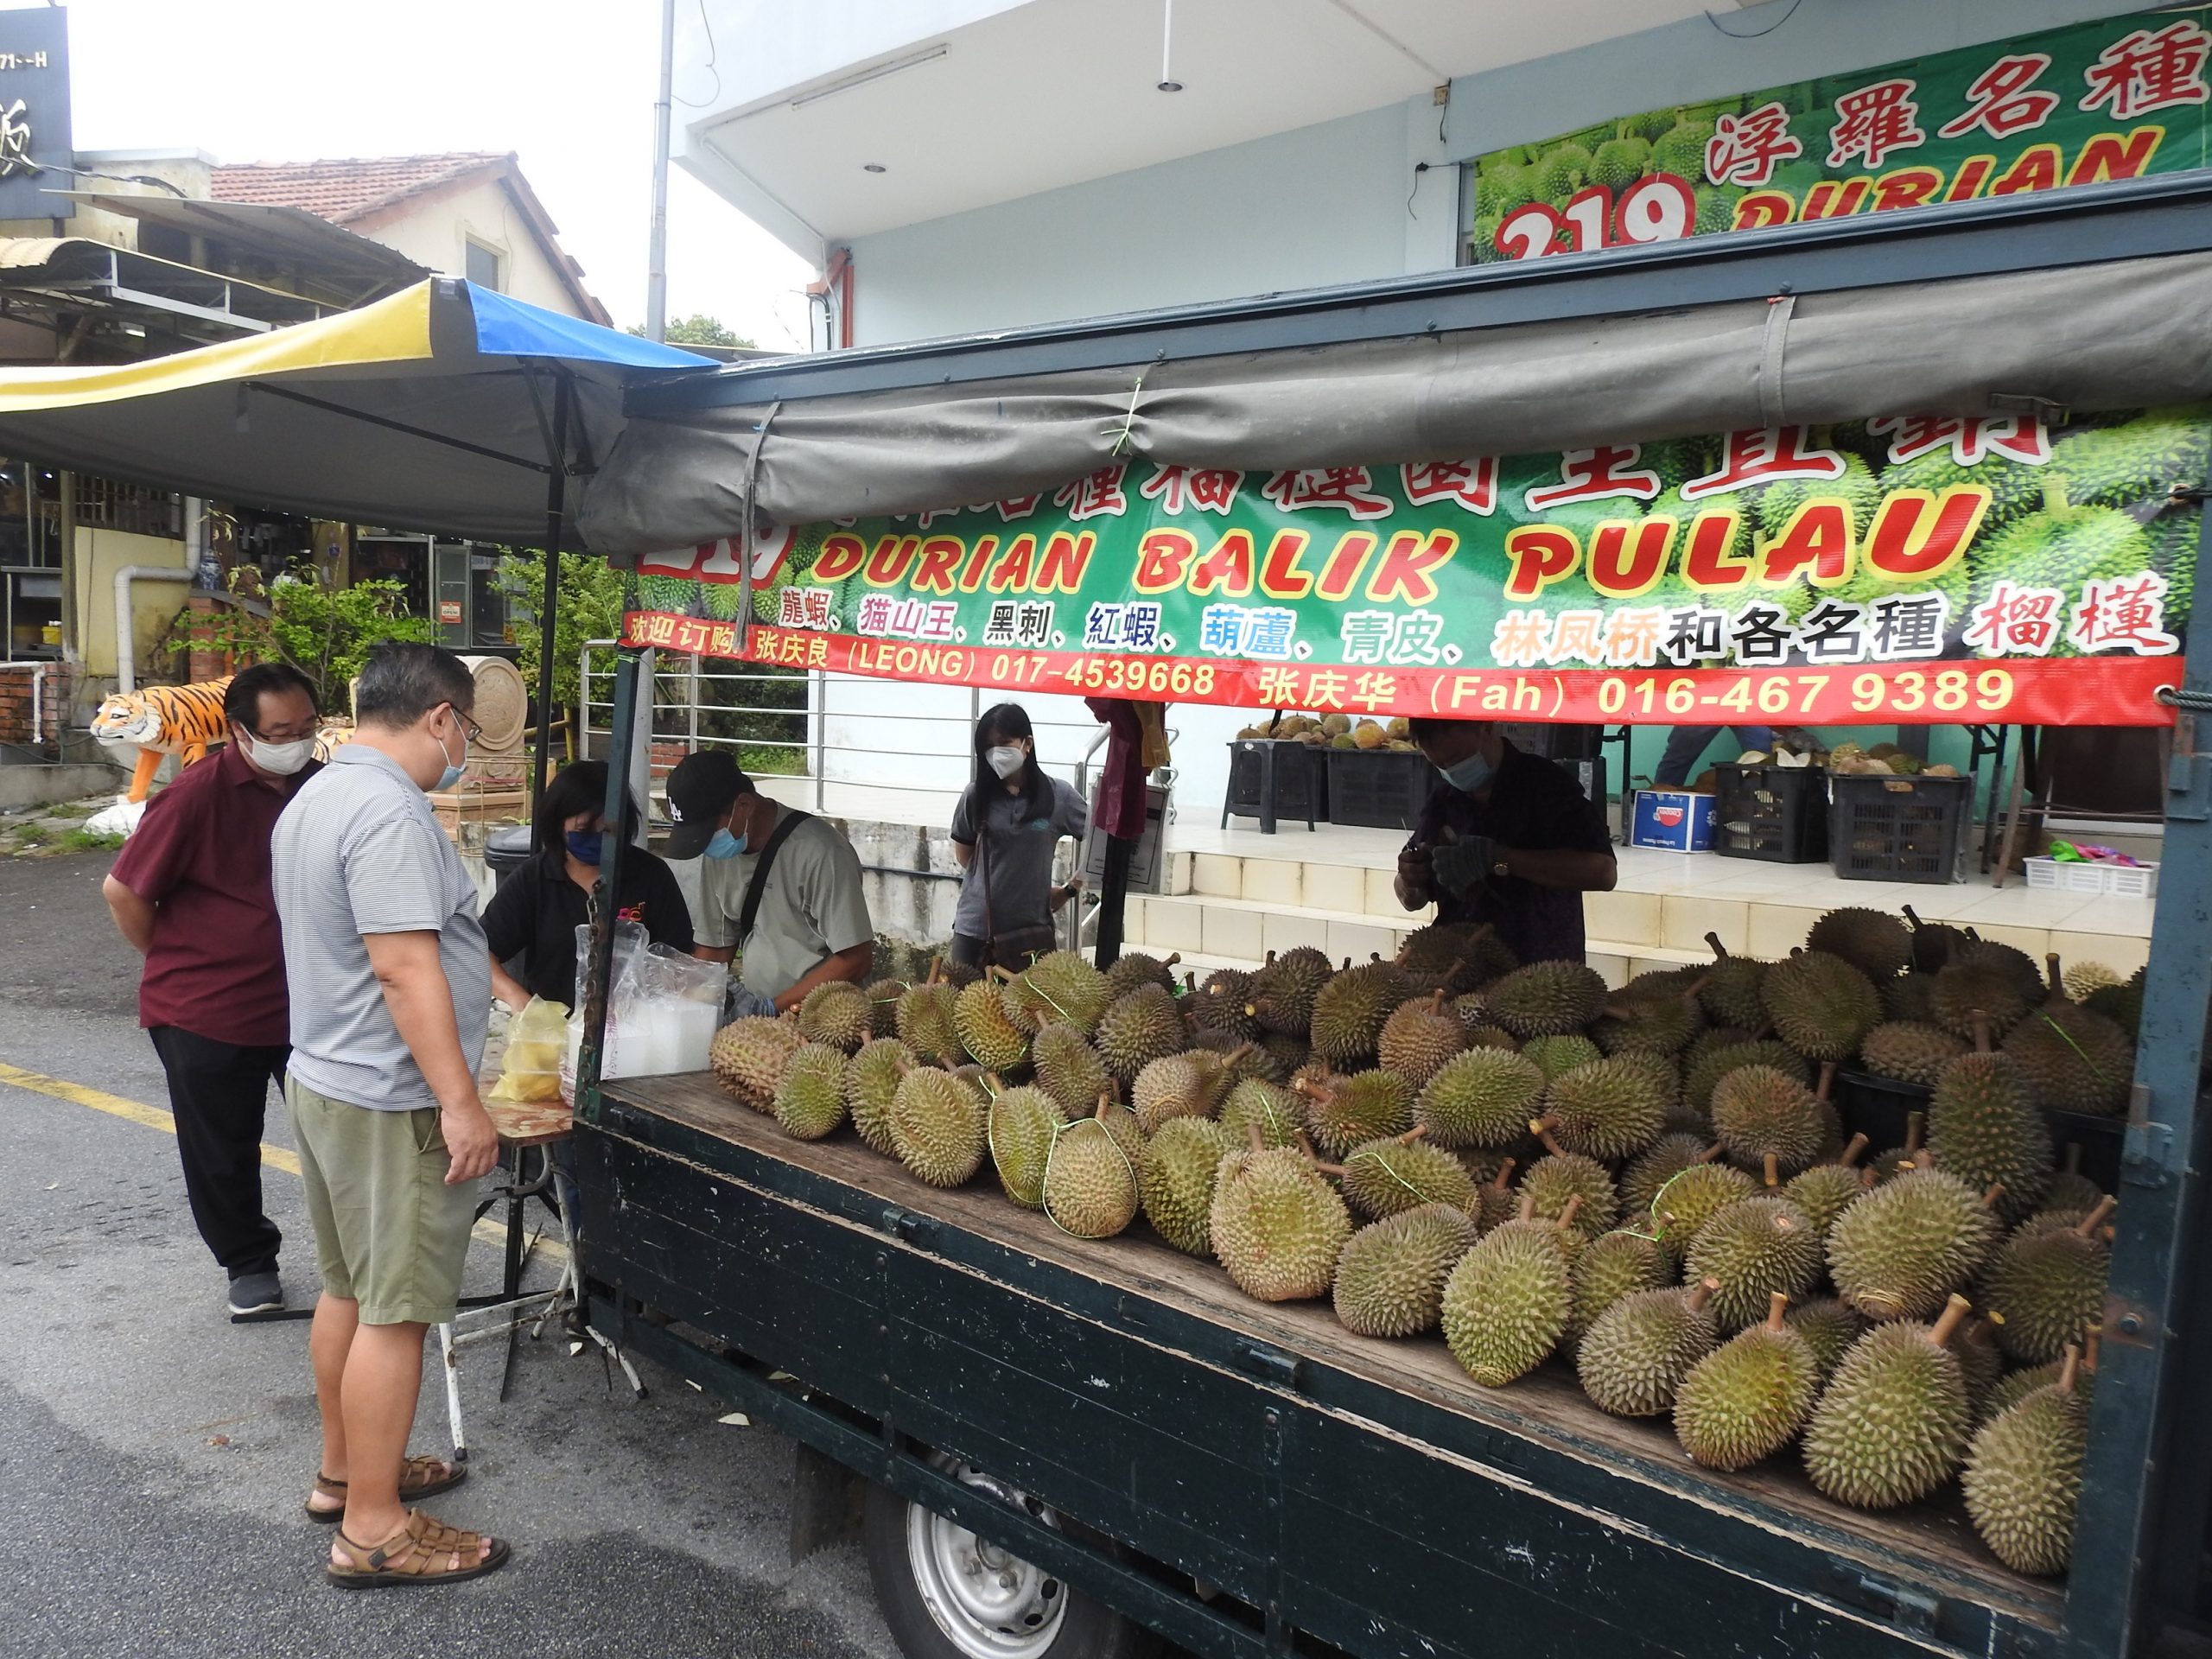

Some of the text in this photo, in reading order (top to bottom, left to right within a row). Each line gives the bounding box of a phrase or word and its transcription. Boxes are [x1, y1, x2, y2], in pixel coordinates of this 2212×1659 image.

[1705, 19, 2210, 187] 浮羅名種
[1495, 173, 1695, 259] 219
[810, 531, 1096, 595] DURIAN
[1132, 527, 1460, 607] BALIK
[1503, 484, 1992, 601] PULAU
[755, 630, 830, 668] 张庆良
[848, 640, 976, 682] (LEONG)
[991, 653, 1215, 696] 017-4539668
[1257, 666, 1398, 712] 张庆华
[1430, 674, 1564, 717] (Fah)
[1599, 675, 1830, 714] 016-467
[1851, 668, 2015, 713] 9389
